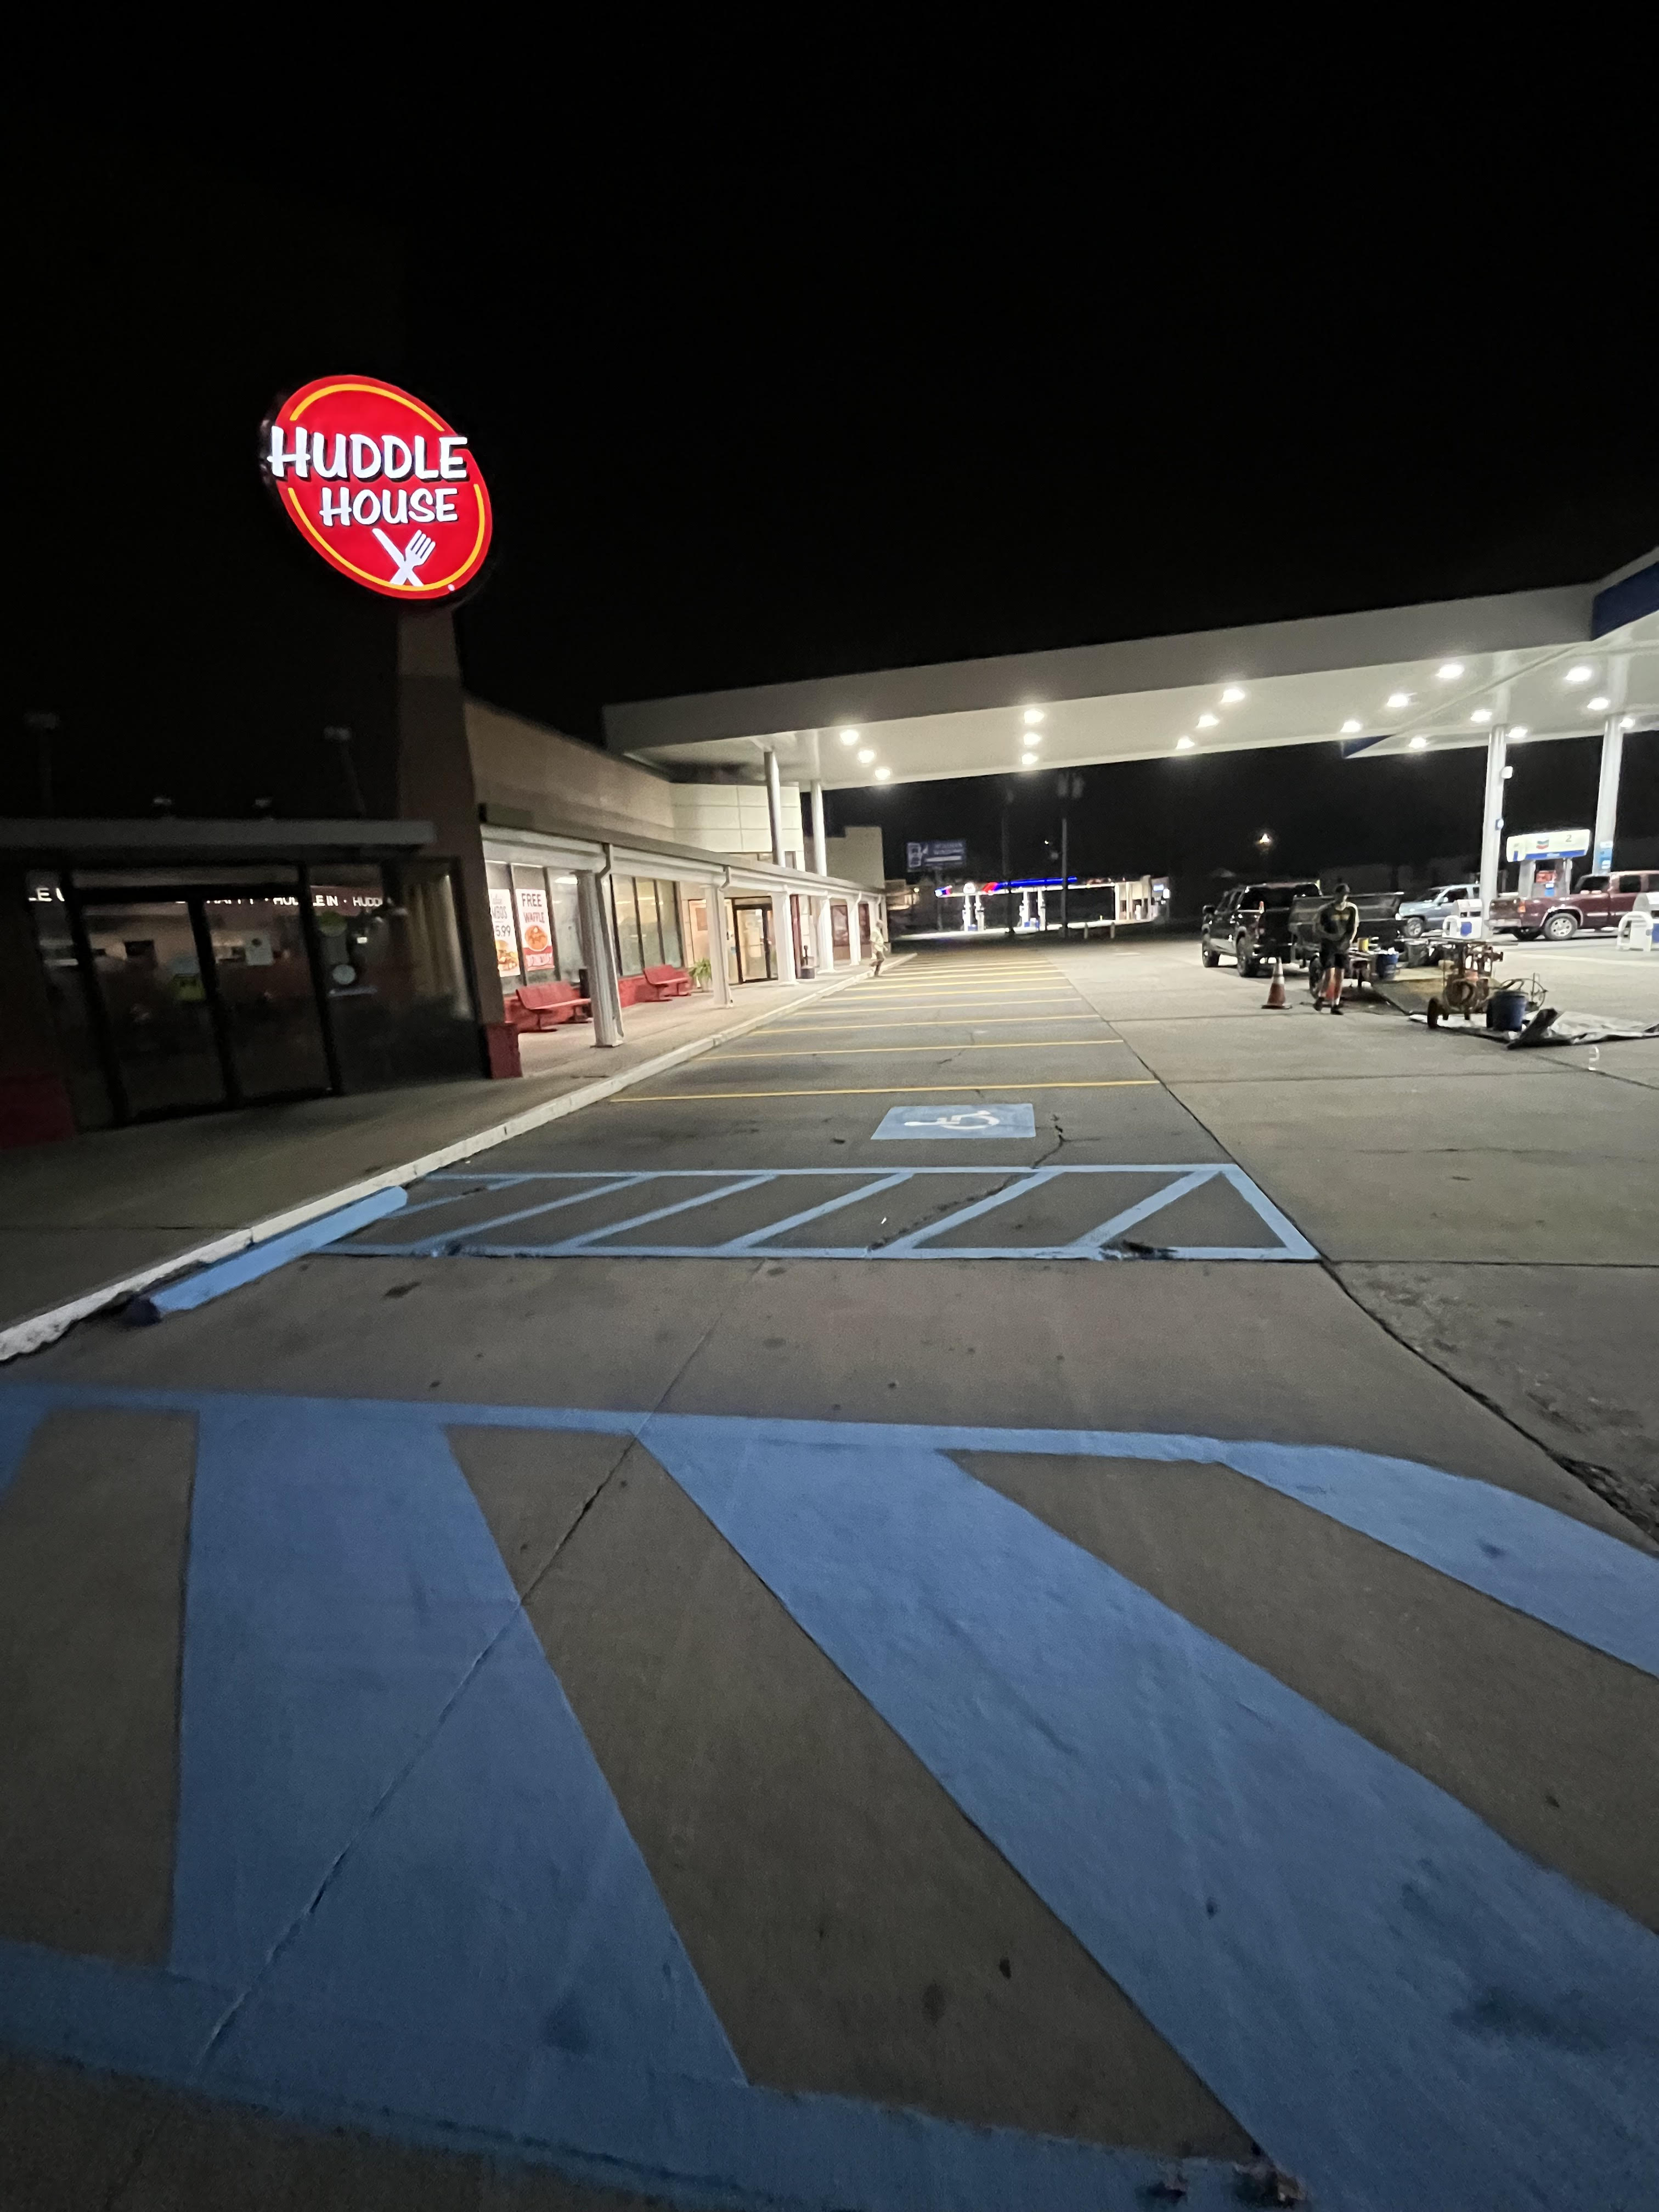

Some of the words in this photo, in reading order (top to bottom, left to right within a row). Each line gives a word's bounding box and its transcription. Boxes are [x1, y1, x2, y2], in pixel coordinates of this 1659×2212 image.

[267, 425, 468, 479] HUDDLE
[319, 487, 458, 527] HOUSE
[522, 893, 542, 907] FREE
